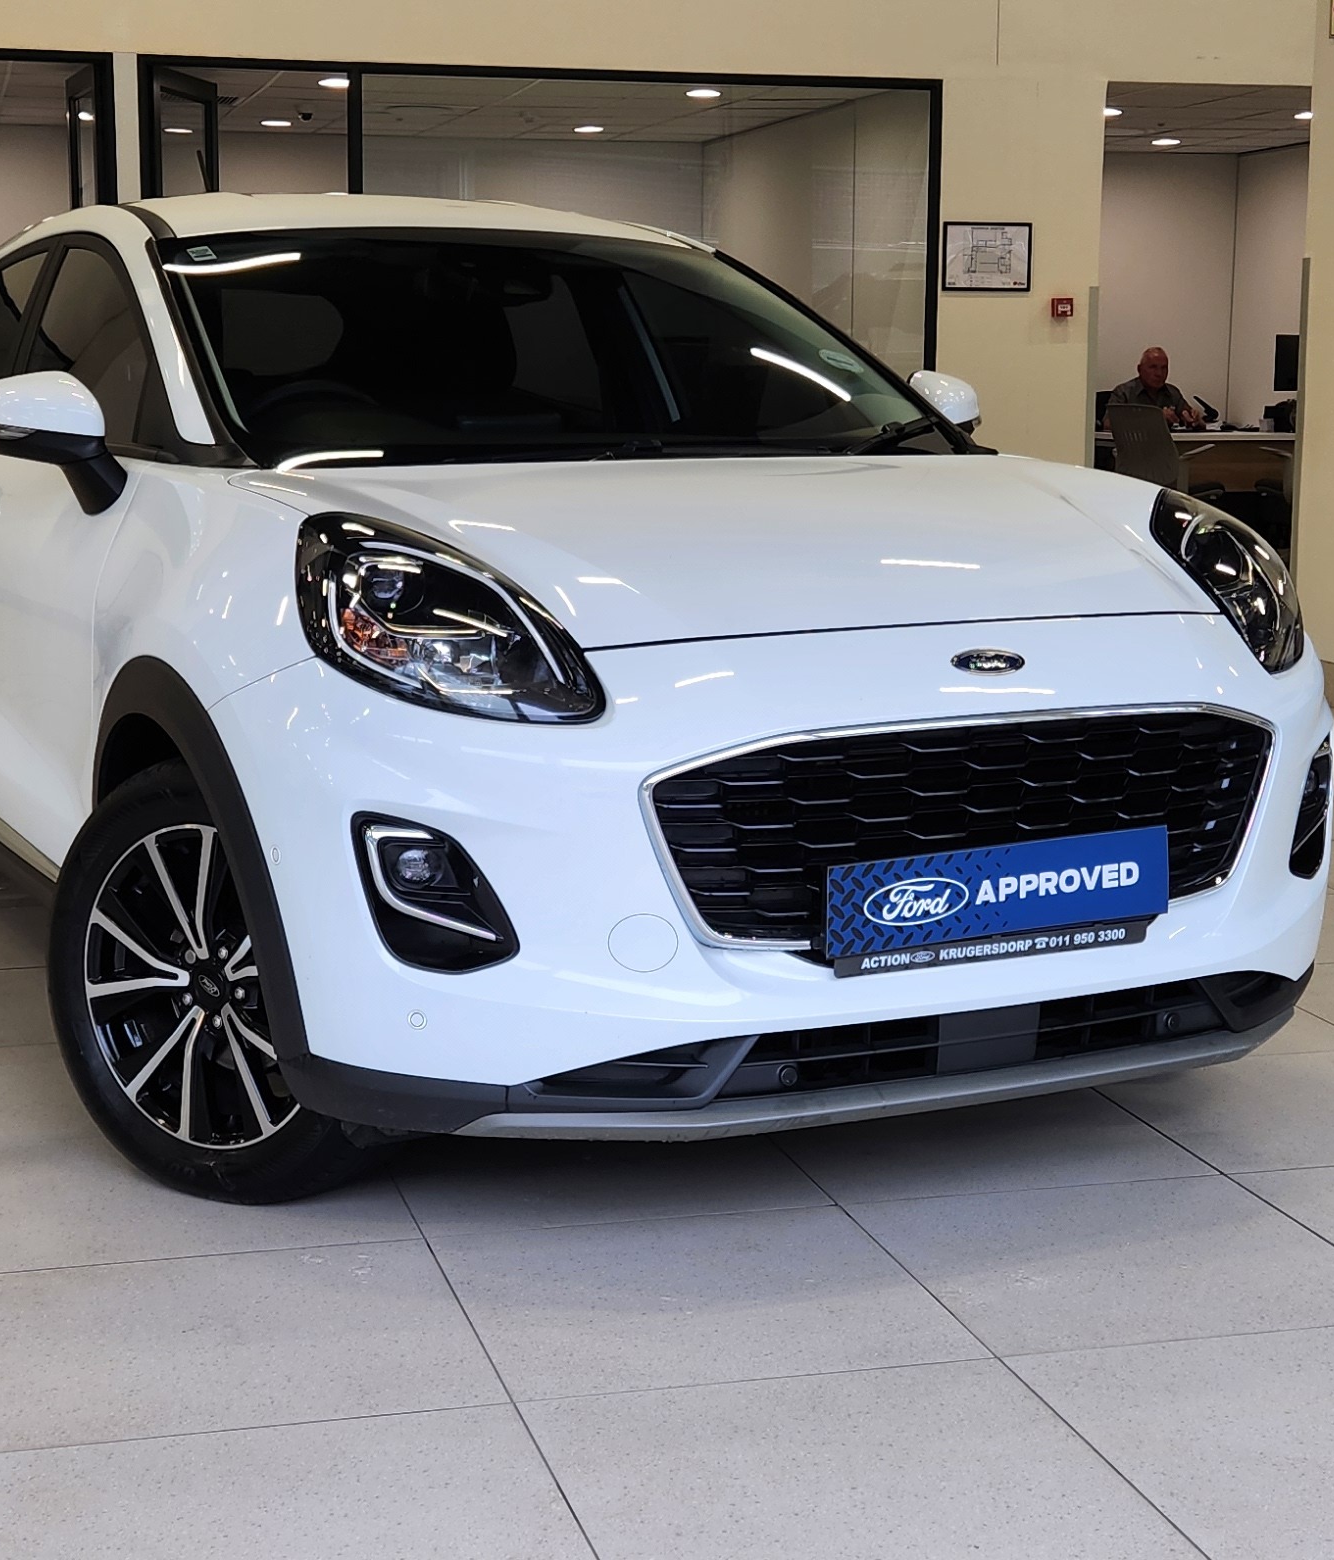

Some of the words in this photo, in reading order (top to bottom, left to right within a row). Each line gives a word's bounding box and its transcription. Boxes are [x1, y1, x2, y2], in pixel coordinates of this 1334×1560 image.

[882, 883, 951, 921] Ford
[975, 861, 1140, 906] APPROVED
[860, 952, 911, 970] ACTION
[939, 939, 1033, 961] KRUGERSDORP
[1049, 935, 1071, 948] 011
[1074, 931, 1095, 945] 950
[1098, 928, 1126, 942] 3300
